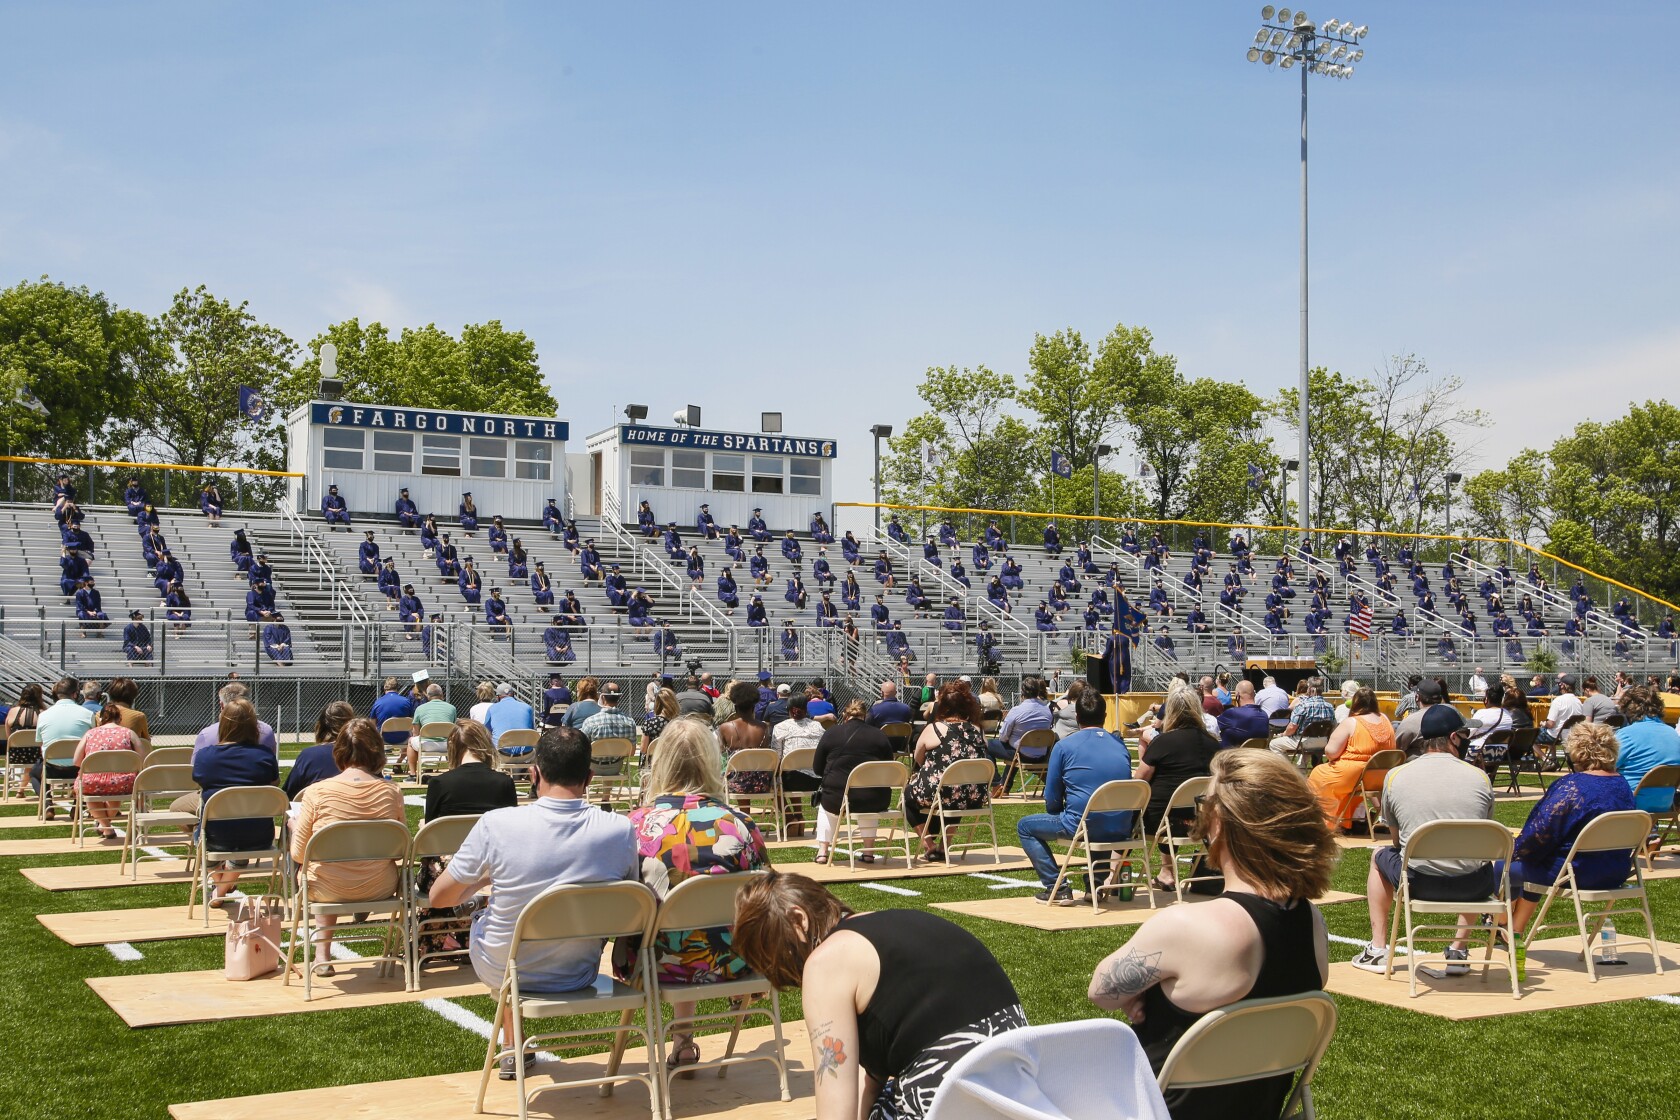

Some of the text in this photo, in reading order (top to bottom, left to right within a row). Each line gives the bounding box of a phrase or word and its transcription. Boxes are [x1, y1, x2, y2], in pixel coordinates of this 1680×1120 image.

[354, 409, 556, 438] FARGO NORTH
[627, 429, 818, 455] HOME OF THE SPARTANS
